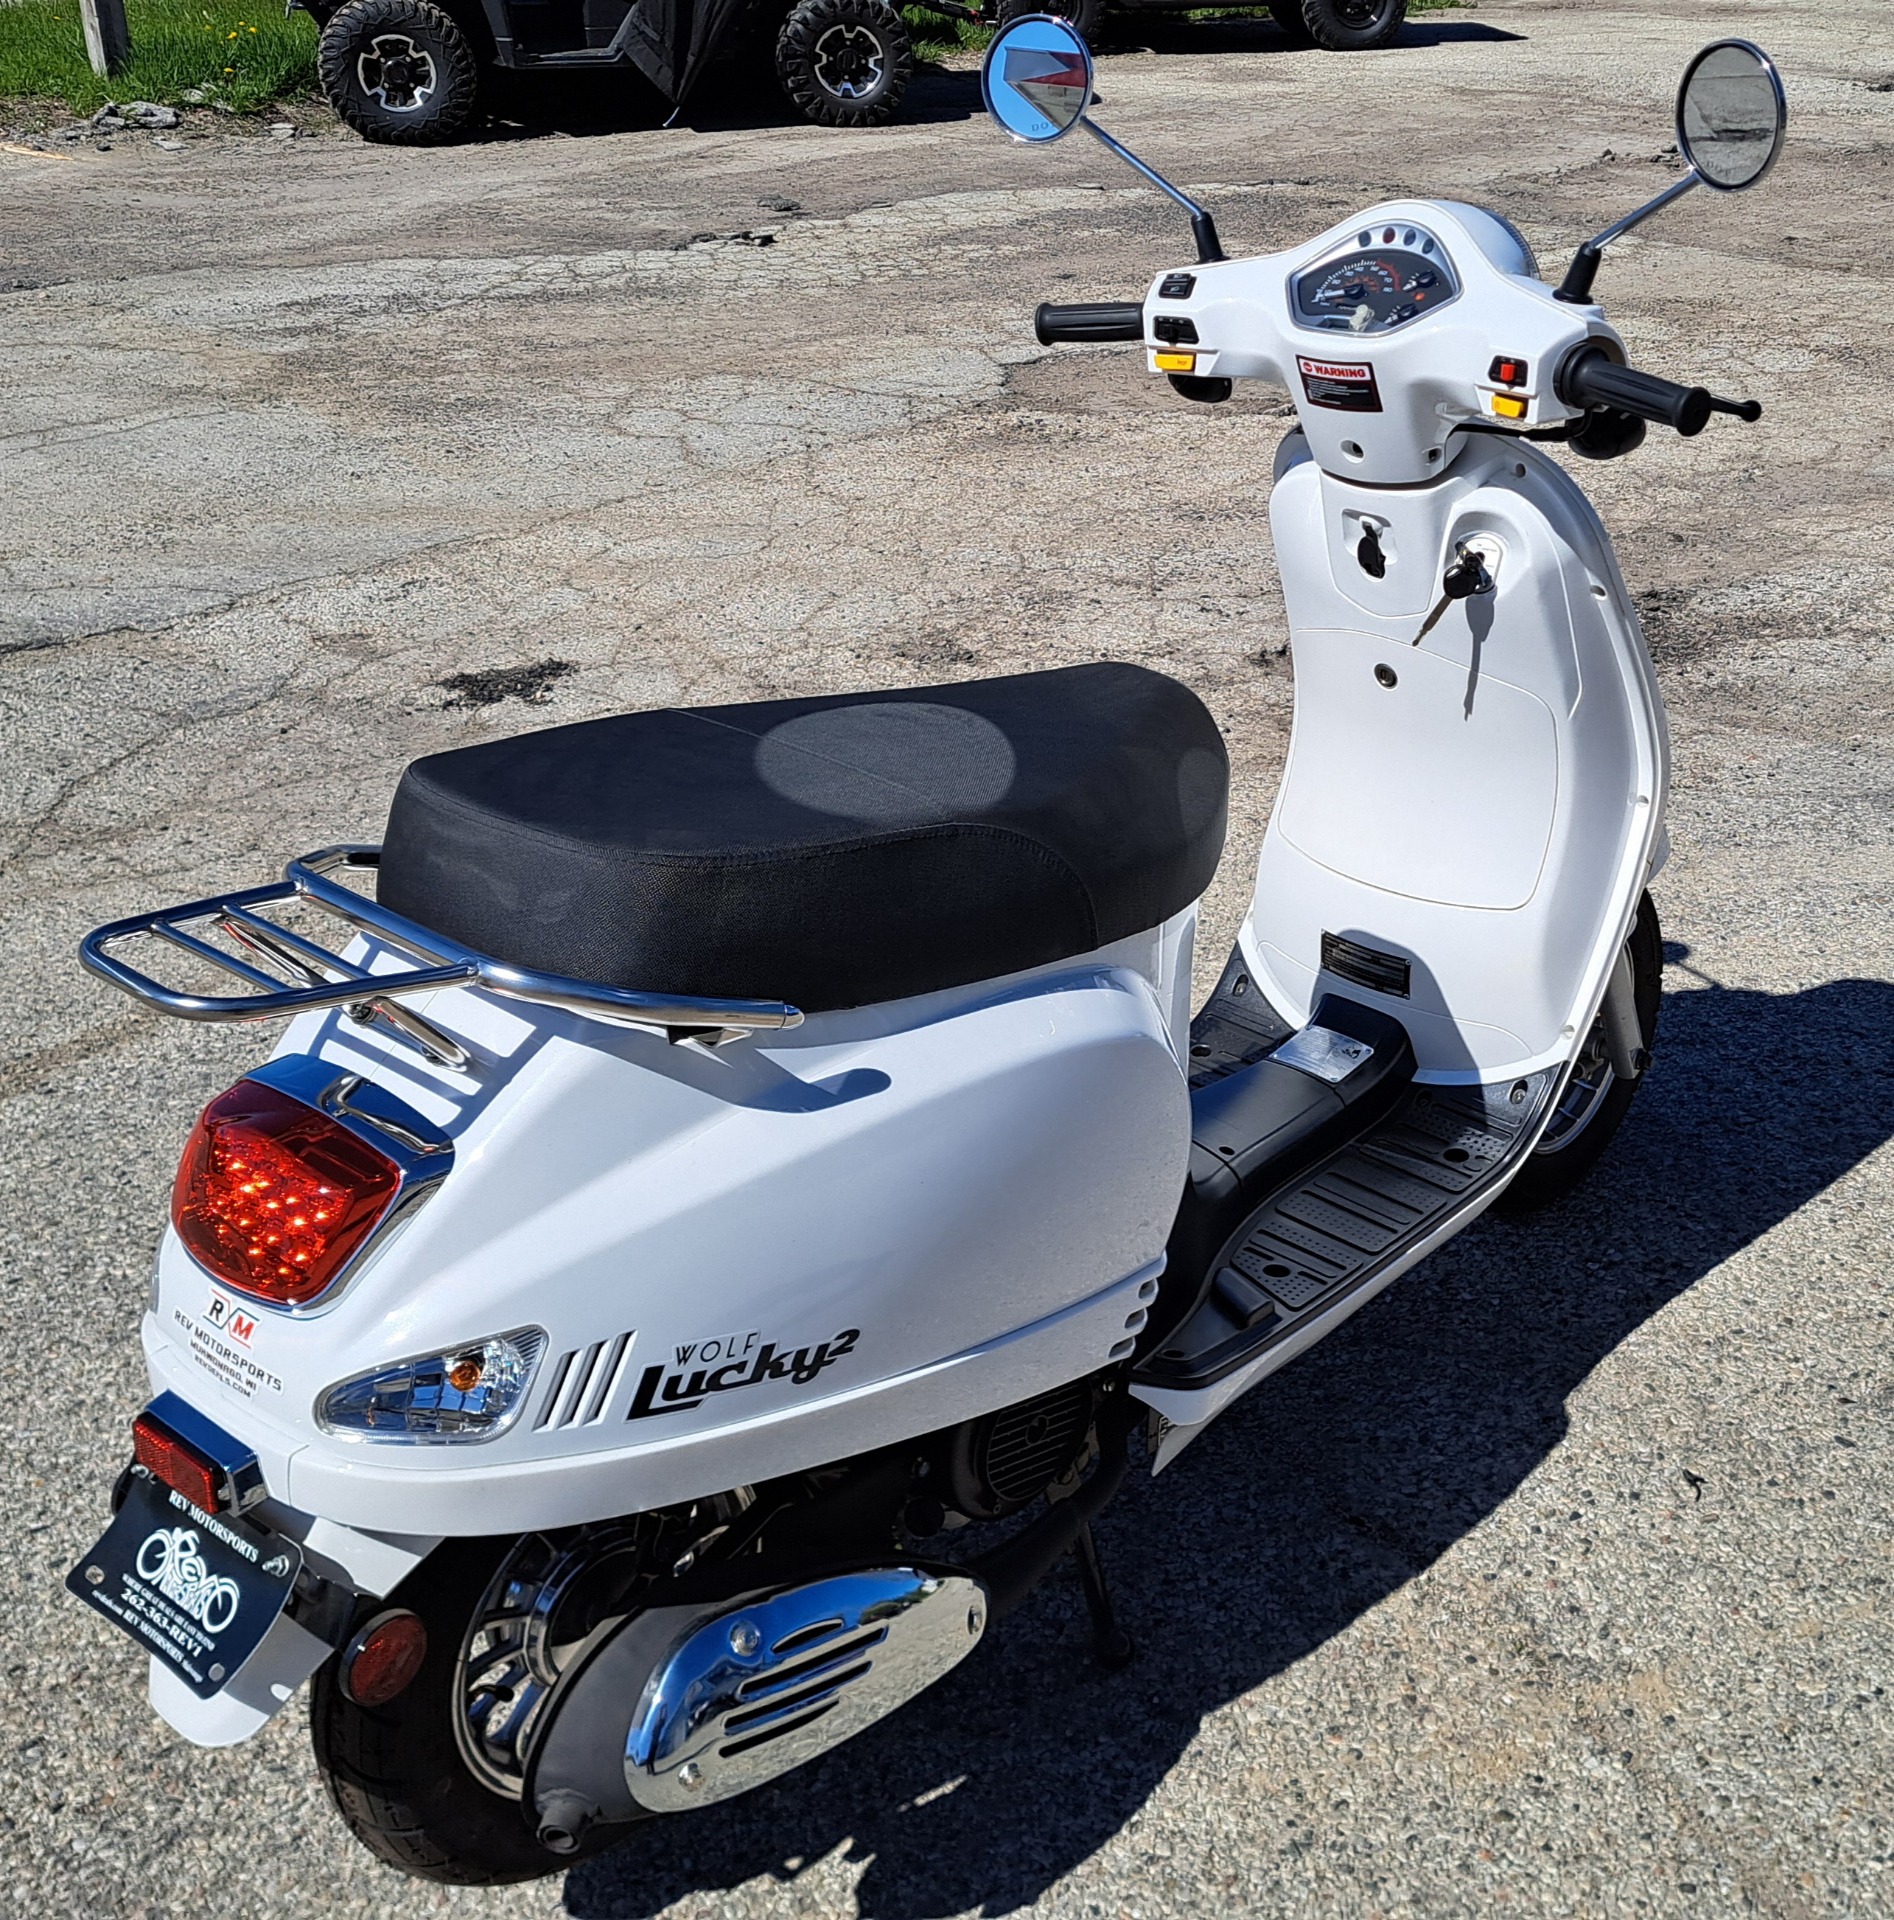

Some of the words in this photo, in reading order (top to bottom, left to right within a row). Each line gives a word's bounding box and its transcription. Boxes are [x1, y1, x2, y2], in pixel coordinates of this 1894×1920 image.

[1314, 365, 1366, 378] WARNING
[174, 1309, 194, 1331] REV
[194, 1326, 282, 1391] MOTORSPORTS
[675, 1332, 759, 1367] WOLF
[245, 1378, 257, 1391] WI
[168, 1489, 190, 1514] REV
[188, 1506, 259, 1564] MOTORSPORTS
[120, 1588, 205, 1658] 262-363-REV1
